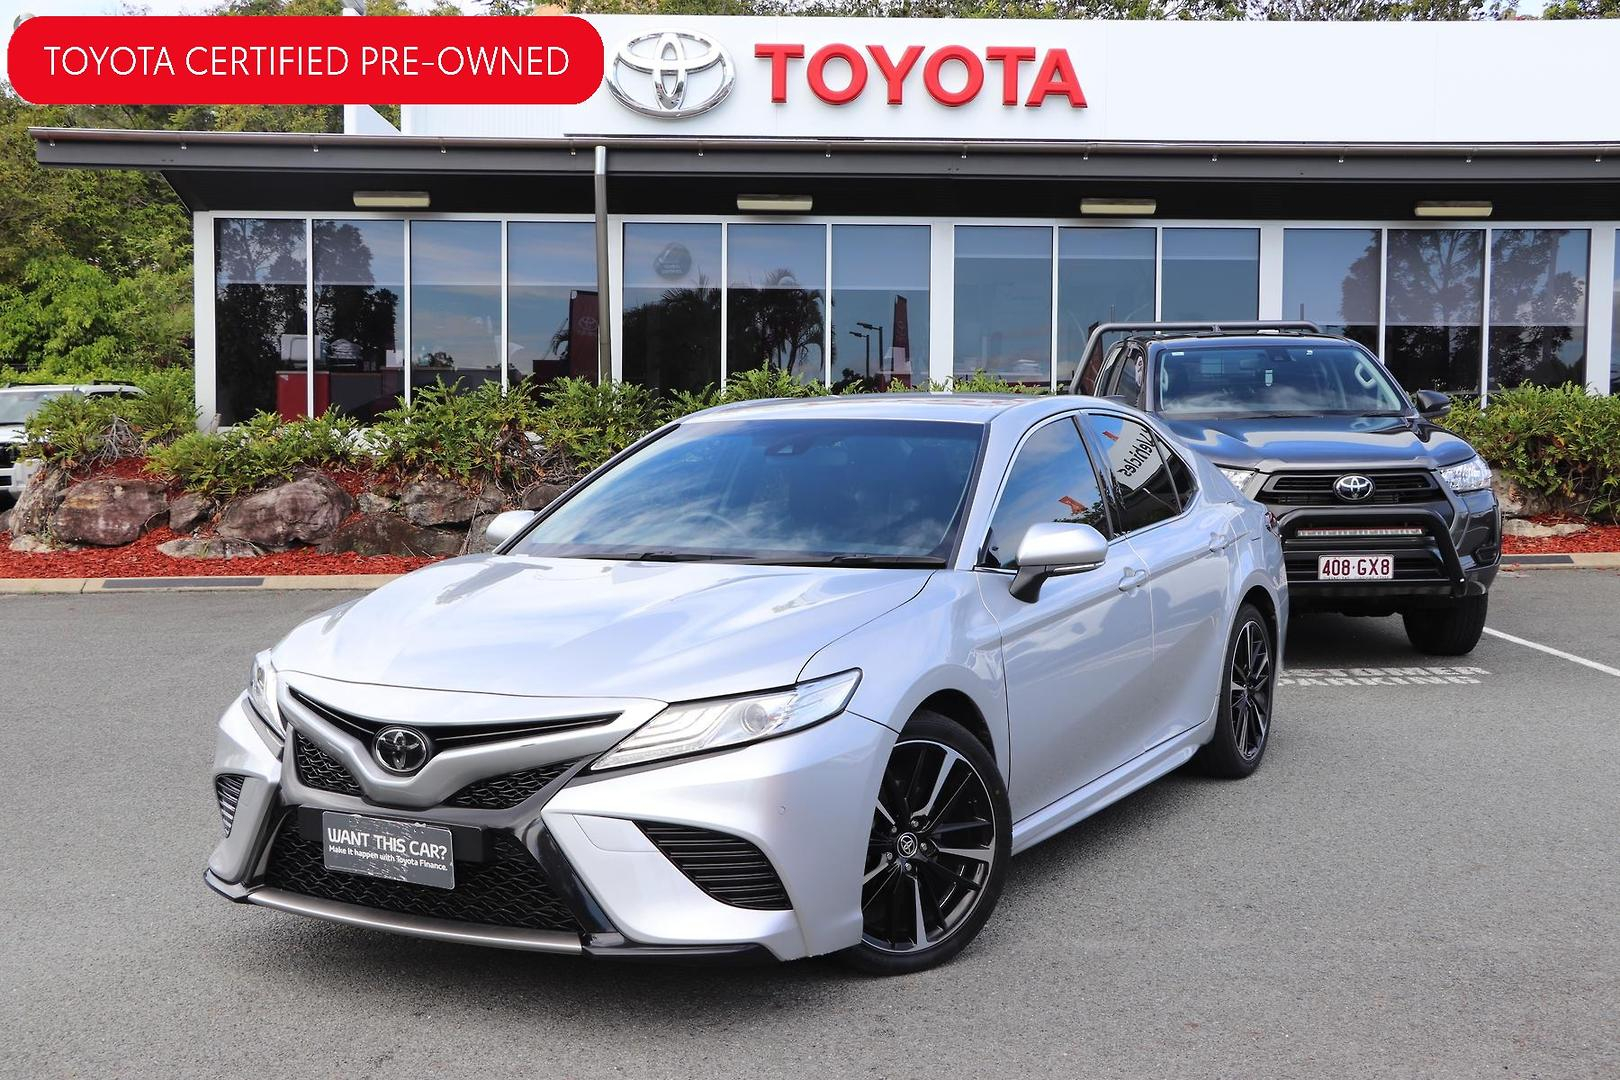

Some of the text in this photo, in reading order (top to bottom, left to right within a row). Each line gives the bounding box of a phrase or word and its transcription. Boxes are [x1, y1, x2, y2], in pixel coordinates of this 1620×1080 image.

[754, 43, 1087, 108] TOYOTA
[327, 827, 448, 861] WANT THIS CAR?
[328, 844, 448, 871] Make it happen with Toyota Finance.
